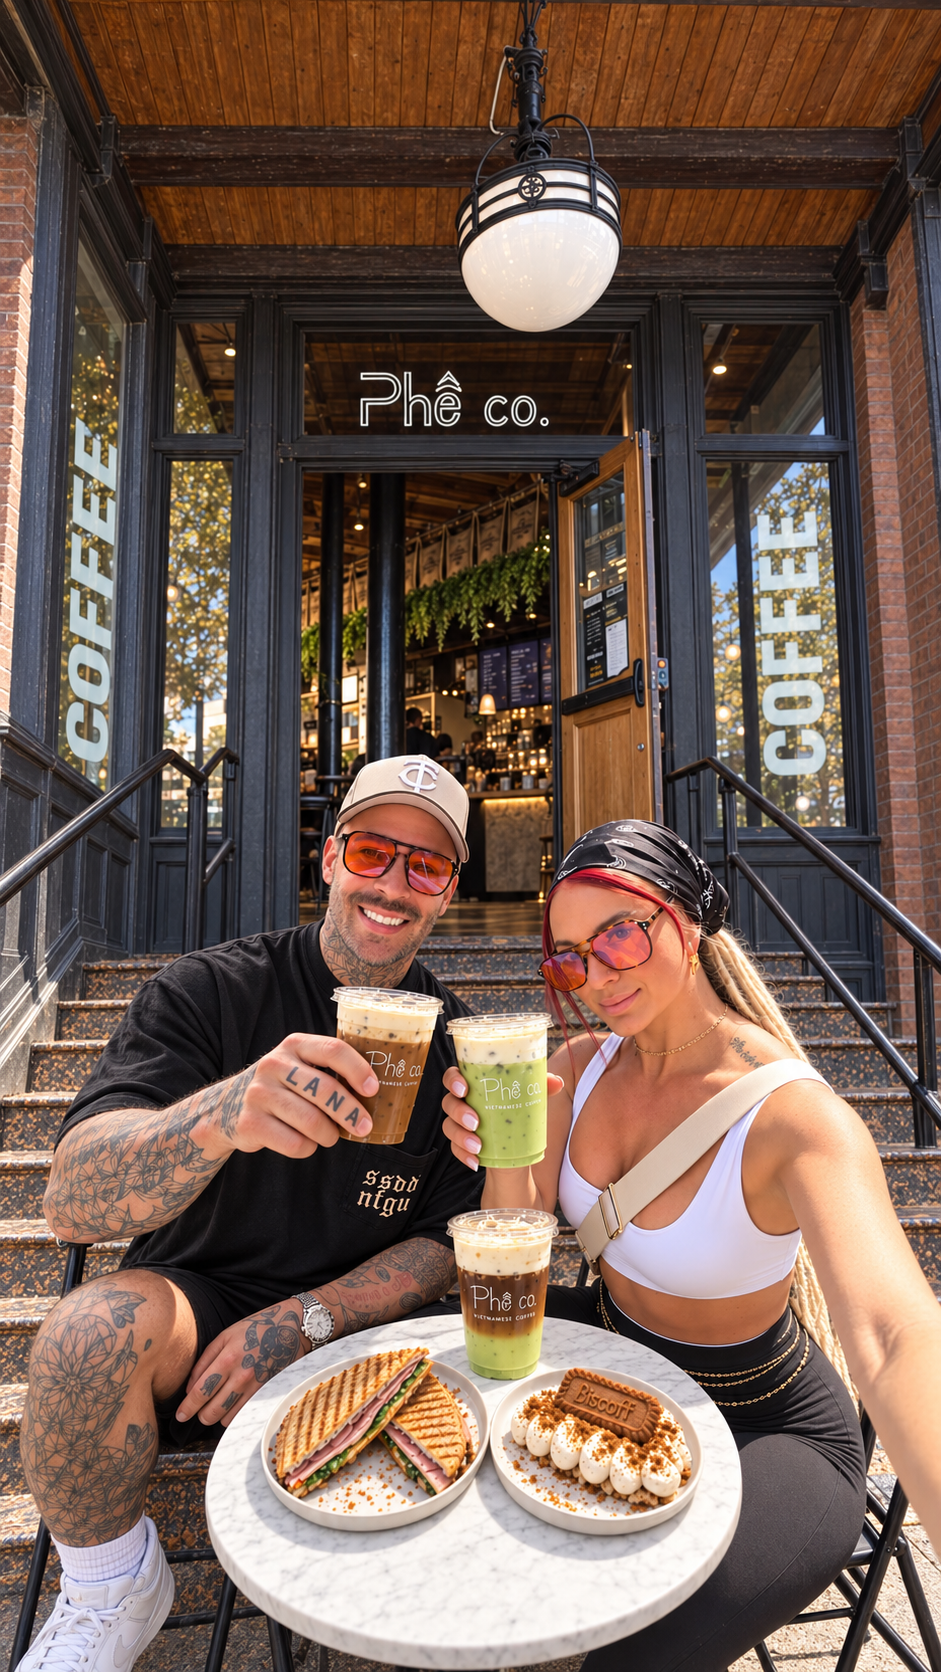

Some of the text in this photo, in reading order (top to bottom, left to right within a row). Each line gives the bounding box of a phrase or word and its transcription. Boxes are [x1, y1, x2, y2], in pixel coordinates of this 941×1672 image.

[360, 370, 549, 427] Phê co.
[65, 416, 118, 764] COFFEE
[757, 511, 827, 776] COFFEE
[285, 1066, 360, 1128] LANA
[479, 1077, 521, 1101] Phê
[469, 1284, 537, 1312] Phê co.
[473, 1312, 512, 1322] VIETNAMESE
[573, 1382, 637, 1420] Biscoff
